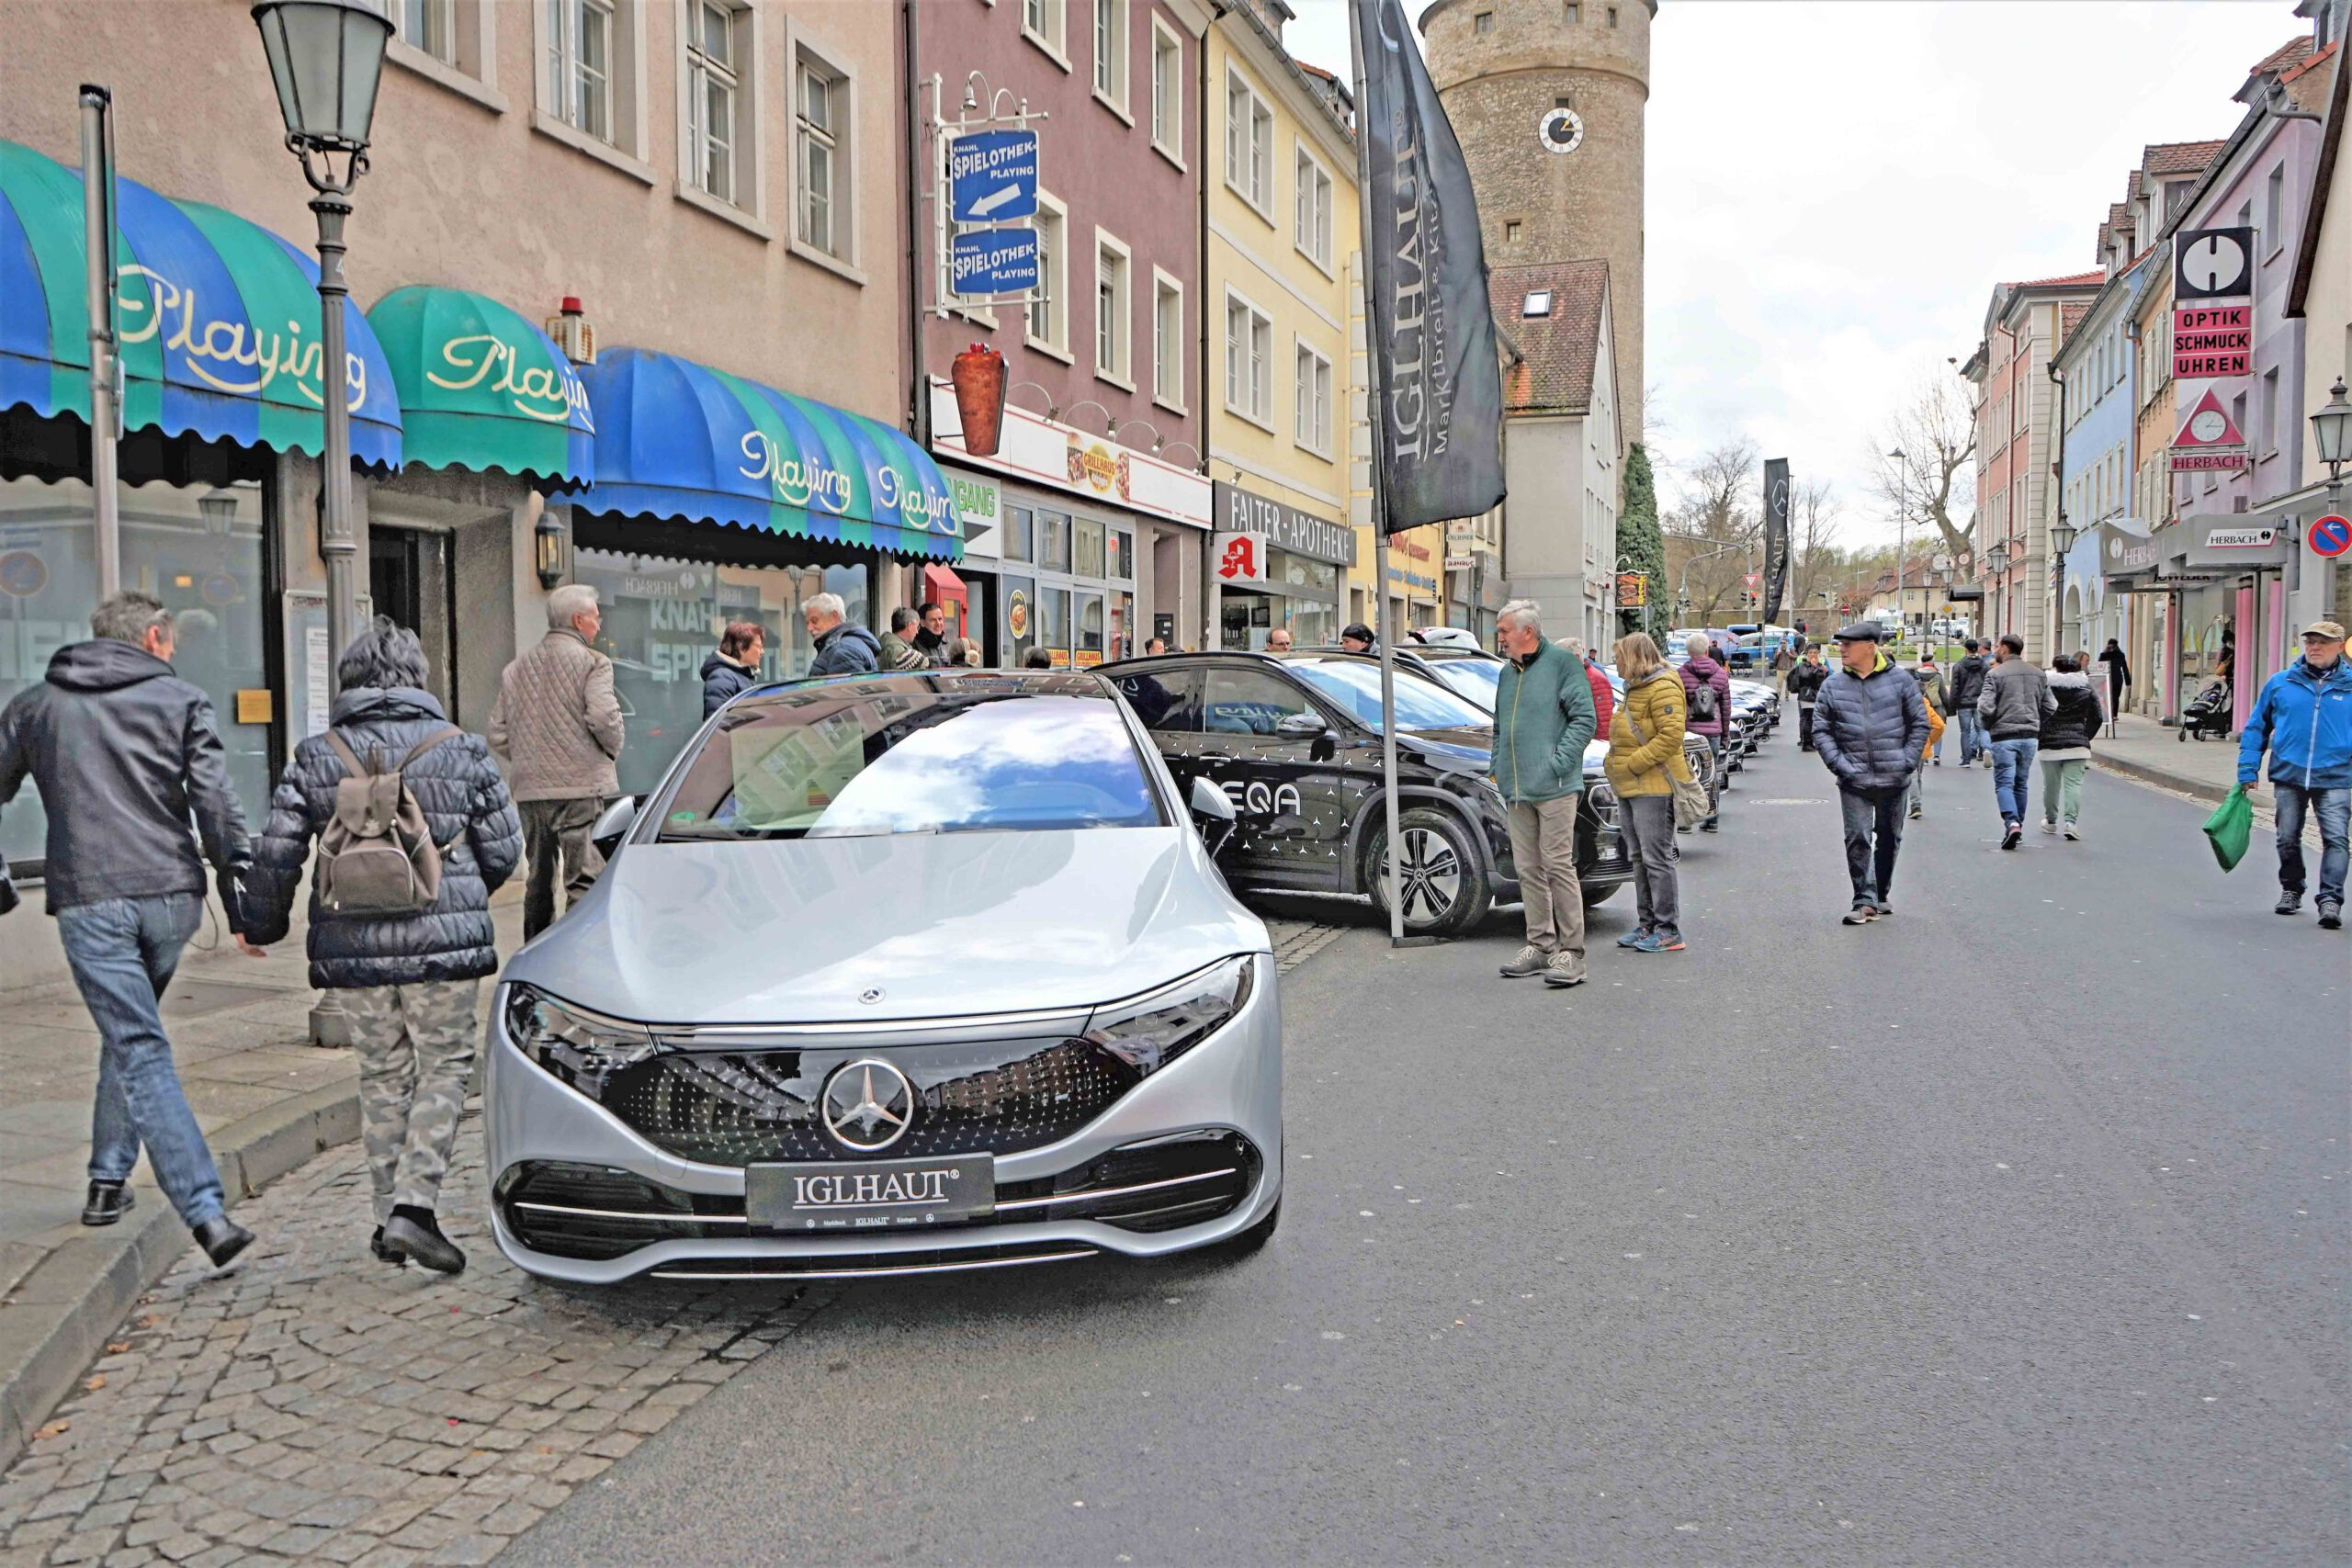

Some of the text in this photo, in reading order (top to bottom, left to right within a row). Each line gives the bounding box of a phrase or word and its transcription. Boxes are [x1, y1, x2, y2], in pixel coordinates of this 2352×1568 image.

[954, 144, 978, 152] KNAHL
[954, 141, 1034, 180] SPIELOTHEK
[990, 165, 1034, 179] PLAYING
[956, 245, 980, 254] KNAHL
[956, 243, 1035, 280] SPIELOTHEK
[991, 267, 1035, 280] PLAYING
[2183, 310, 2242, 328] OPTIK
[2176, 333, 2248, 351] SCHMUCK
[2178, 355, 2244, 374] UHREN
[1430, 293, 1452, 455] Marktbreit
[739, 430, 851, 513] Playing
[1083, 453, 1115, 476] GRILLHAUS
[2174, 456, 2244, 469] HERBACH
[2211, 536, 2257, 545] HERBACH
[1076, 650, 1101, 662] GRILLHAUS
[1220, 781, 1301, 816] EQA
